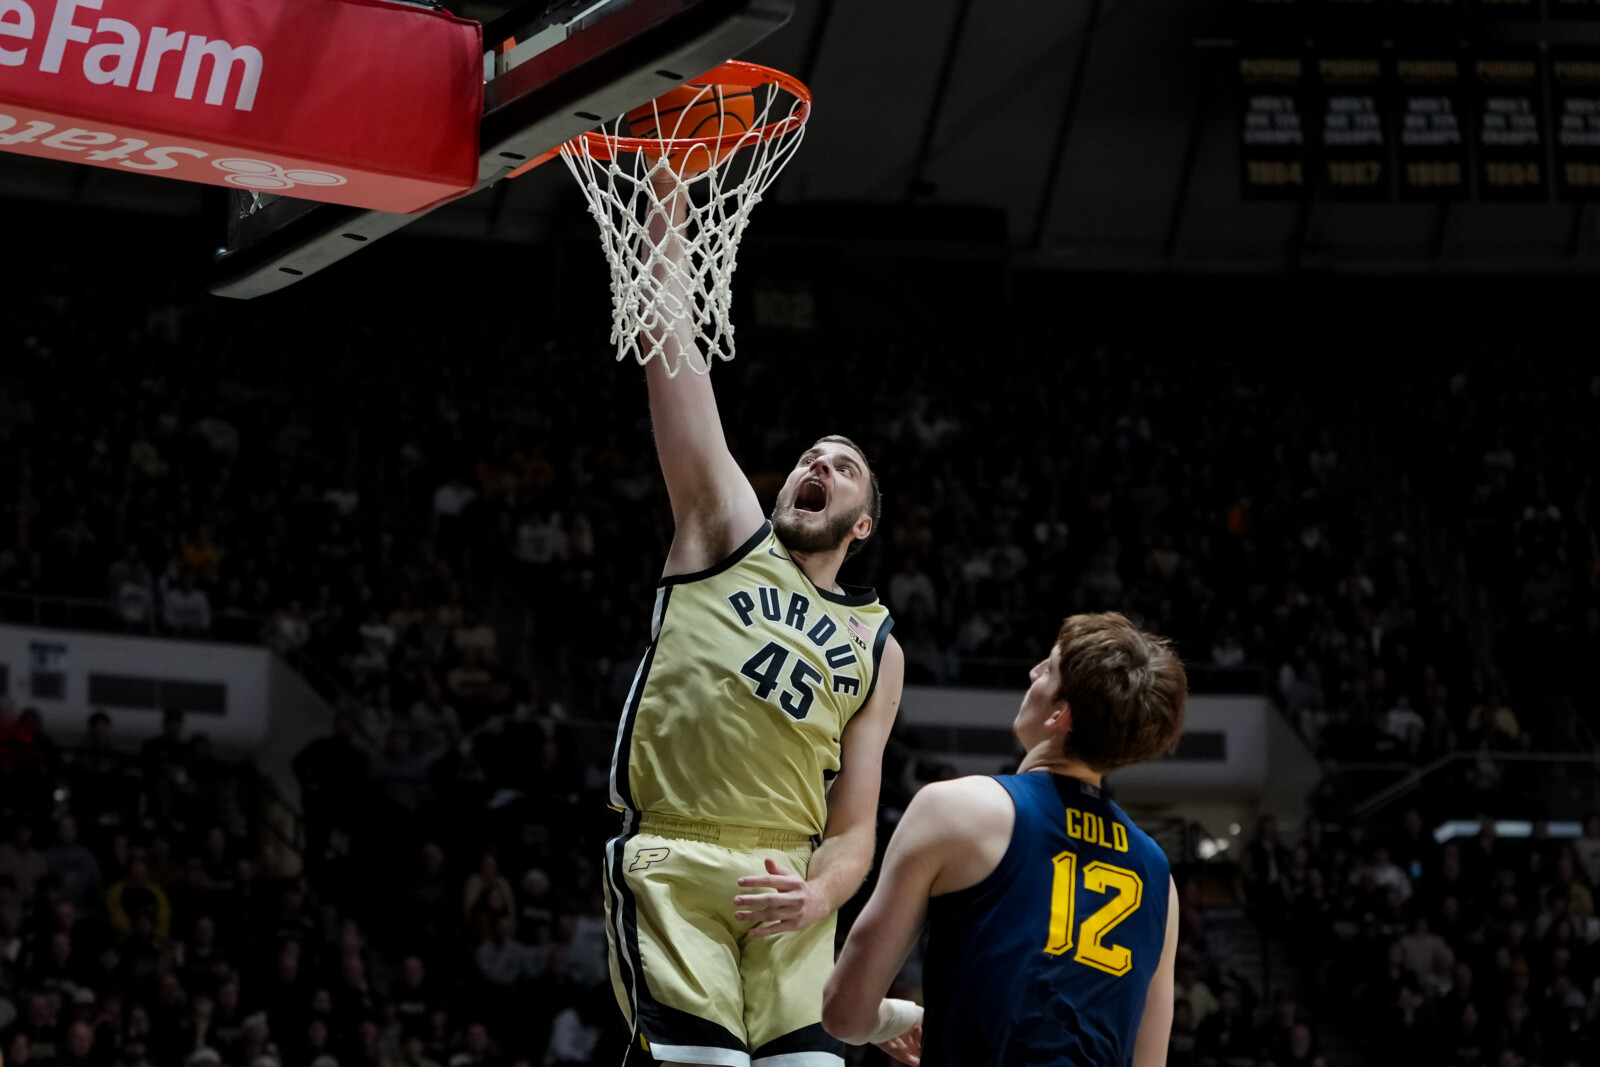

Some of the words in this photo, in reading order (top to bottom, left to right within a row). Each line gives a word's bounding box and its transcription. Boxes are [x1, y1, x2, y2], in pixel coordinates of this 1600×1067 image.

[728, 586, 861, 697] PURDUE
[740, 640, 823, 721] 45
[1065, 806, 1129, 853] GOLD
[1043, 850, 1144, 978] 12
